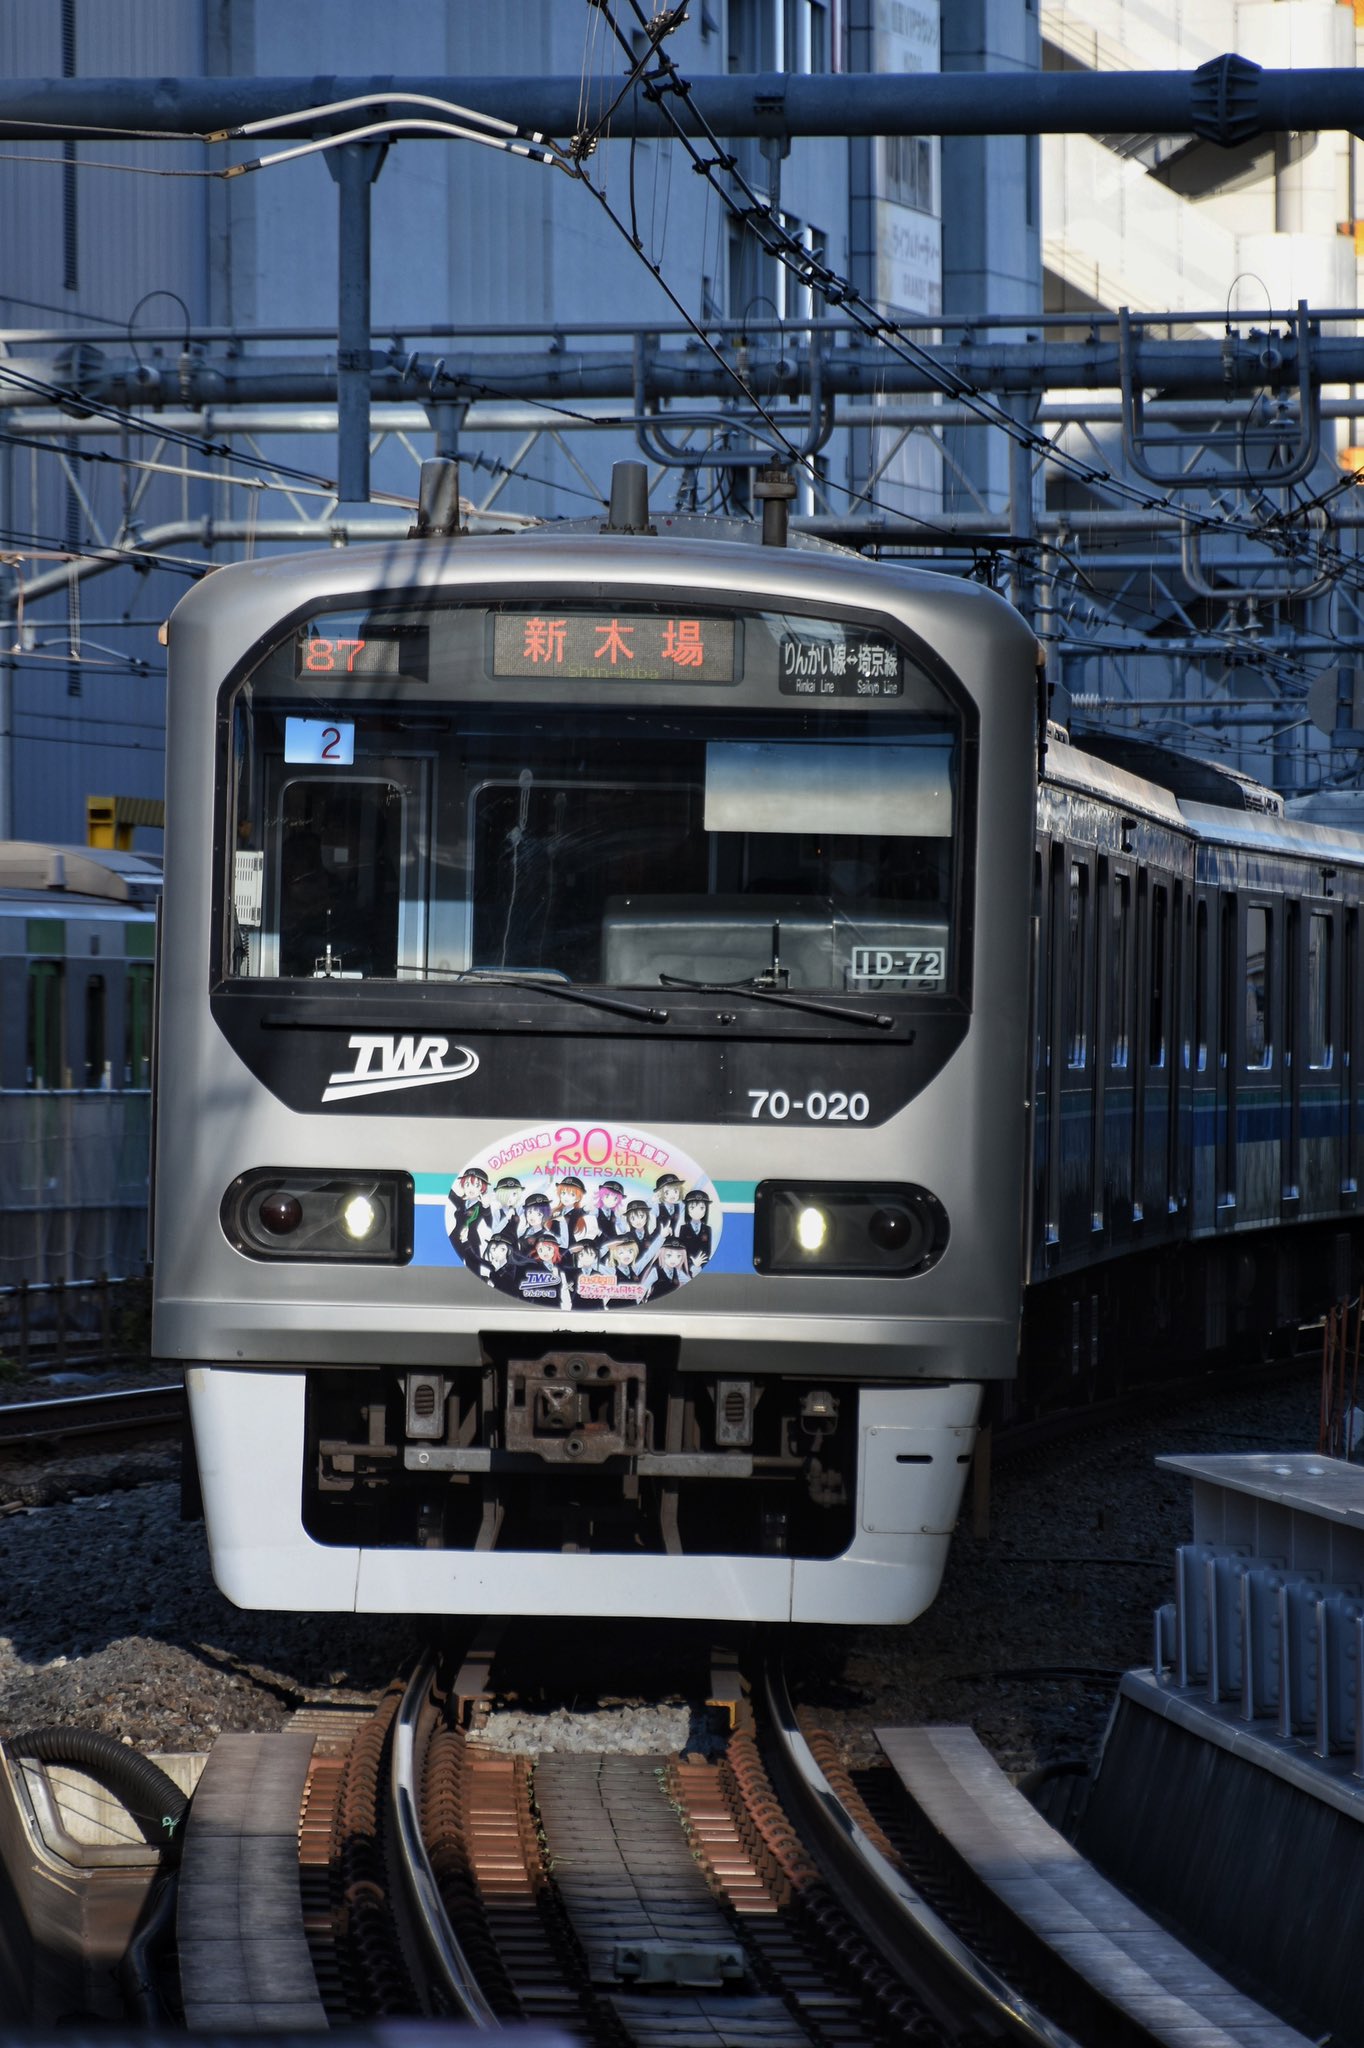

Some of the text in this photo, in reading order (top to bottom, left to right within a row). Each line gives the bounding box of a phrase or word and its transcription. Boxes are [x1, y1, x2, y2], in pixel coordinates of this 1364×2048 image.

[306, 639, 366, 672] 87
[523, 617, 704, 667] 新木場
[785, 642, 898, 677] りんかい線 埼京線
[796, 679, 835, 693] Rinkai Line
[857, 680, 898, 697] Saikyo Line
[321, 727, 341, 759] 2
[863, 952, 939, 975] ID-72
[748, 1091, 870, 1121] 70-020
[533, 1165, 645, 1178] ANNIVERSARY
